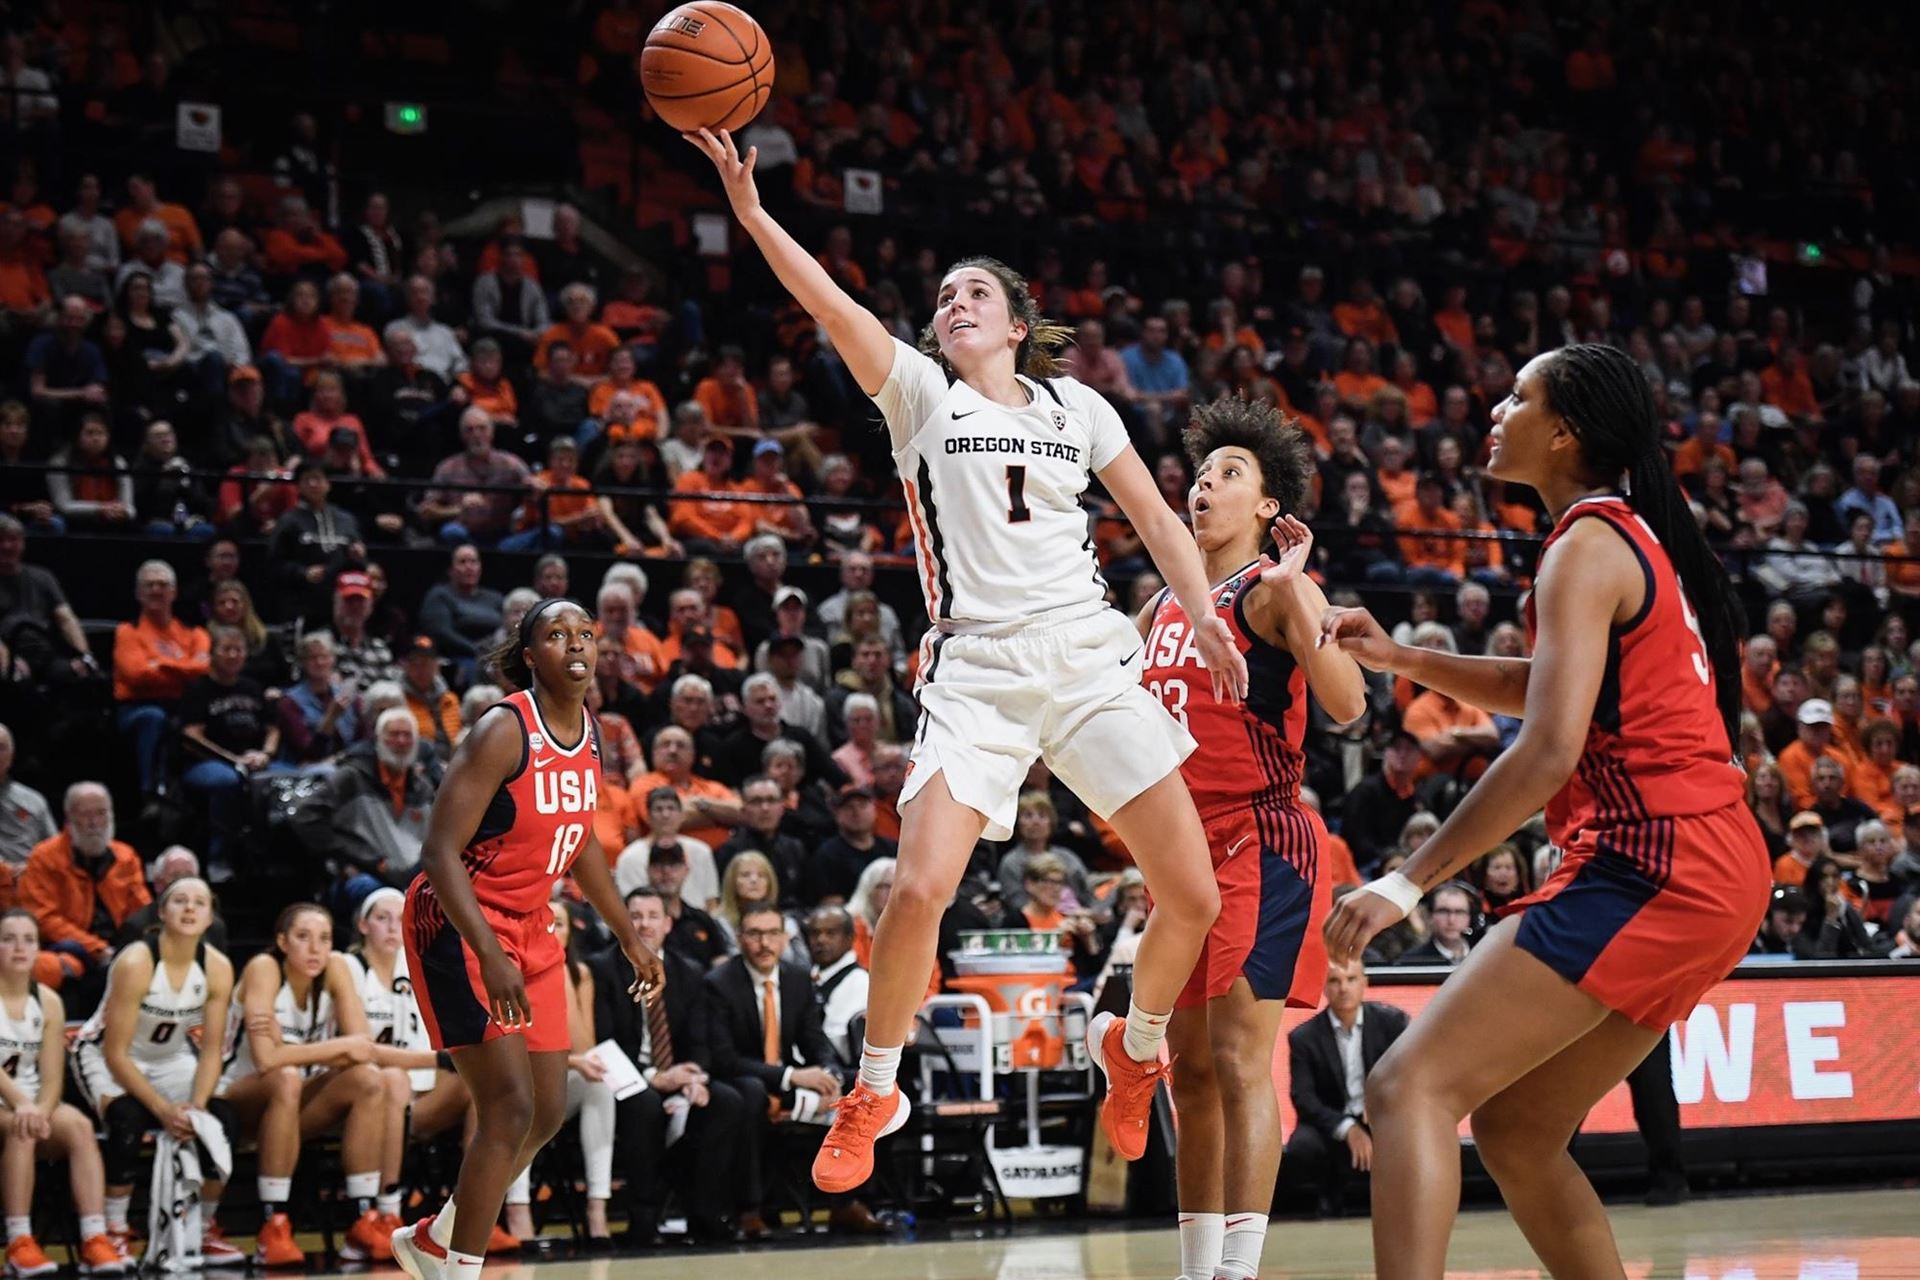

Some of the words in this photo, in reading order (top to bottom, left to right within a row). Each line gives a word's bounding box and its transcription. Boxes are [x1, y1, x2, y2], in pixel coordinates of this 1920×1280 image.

[945, 437, 1025, 455] OREGON
[1031, 441, 1081, 463] STATE
[1005, 464, 1031, 524] 1
[1143, 621, 1208, 671] USA
[534, 768, 598, 815] USA
[545, 823, 585, 875] 18
[150, 1022, 177, 1045] 0
